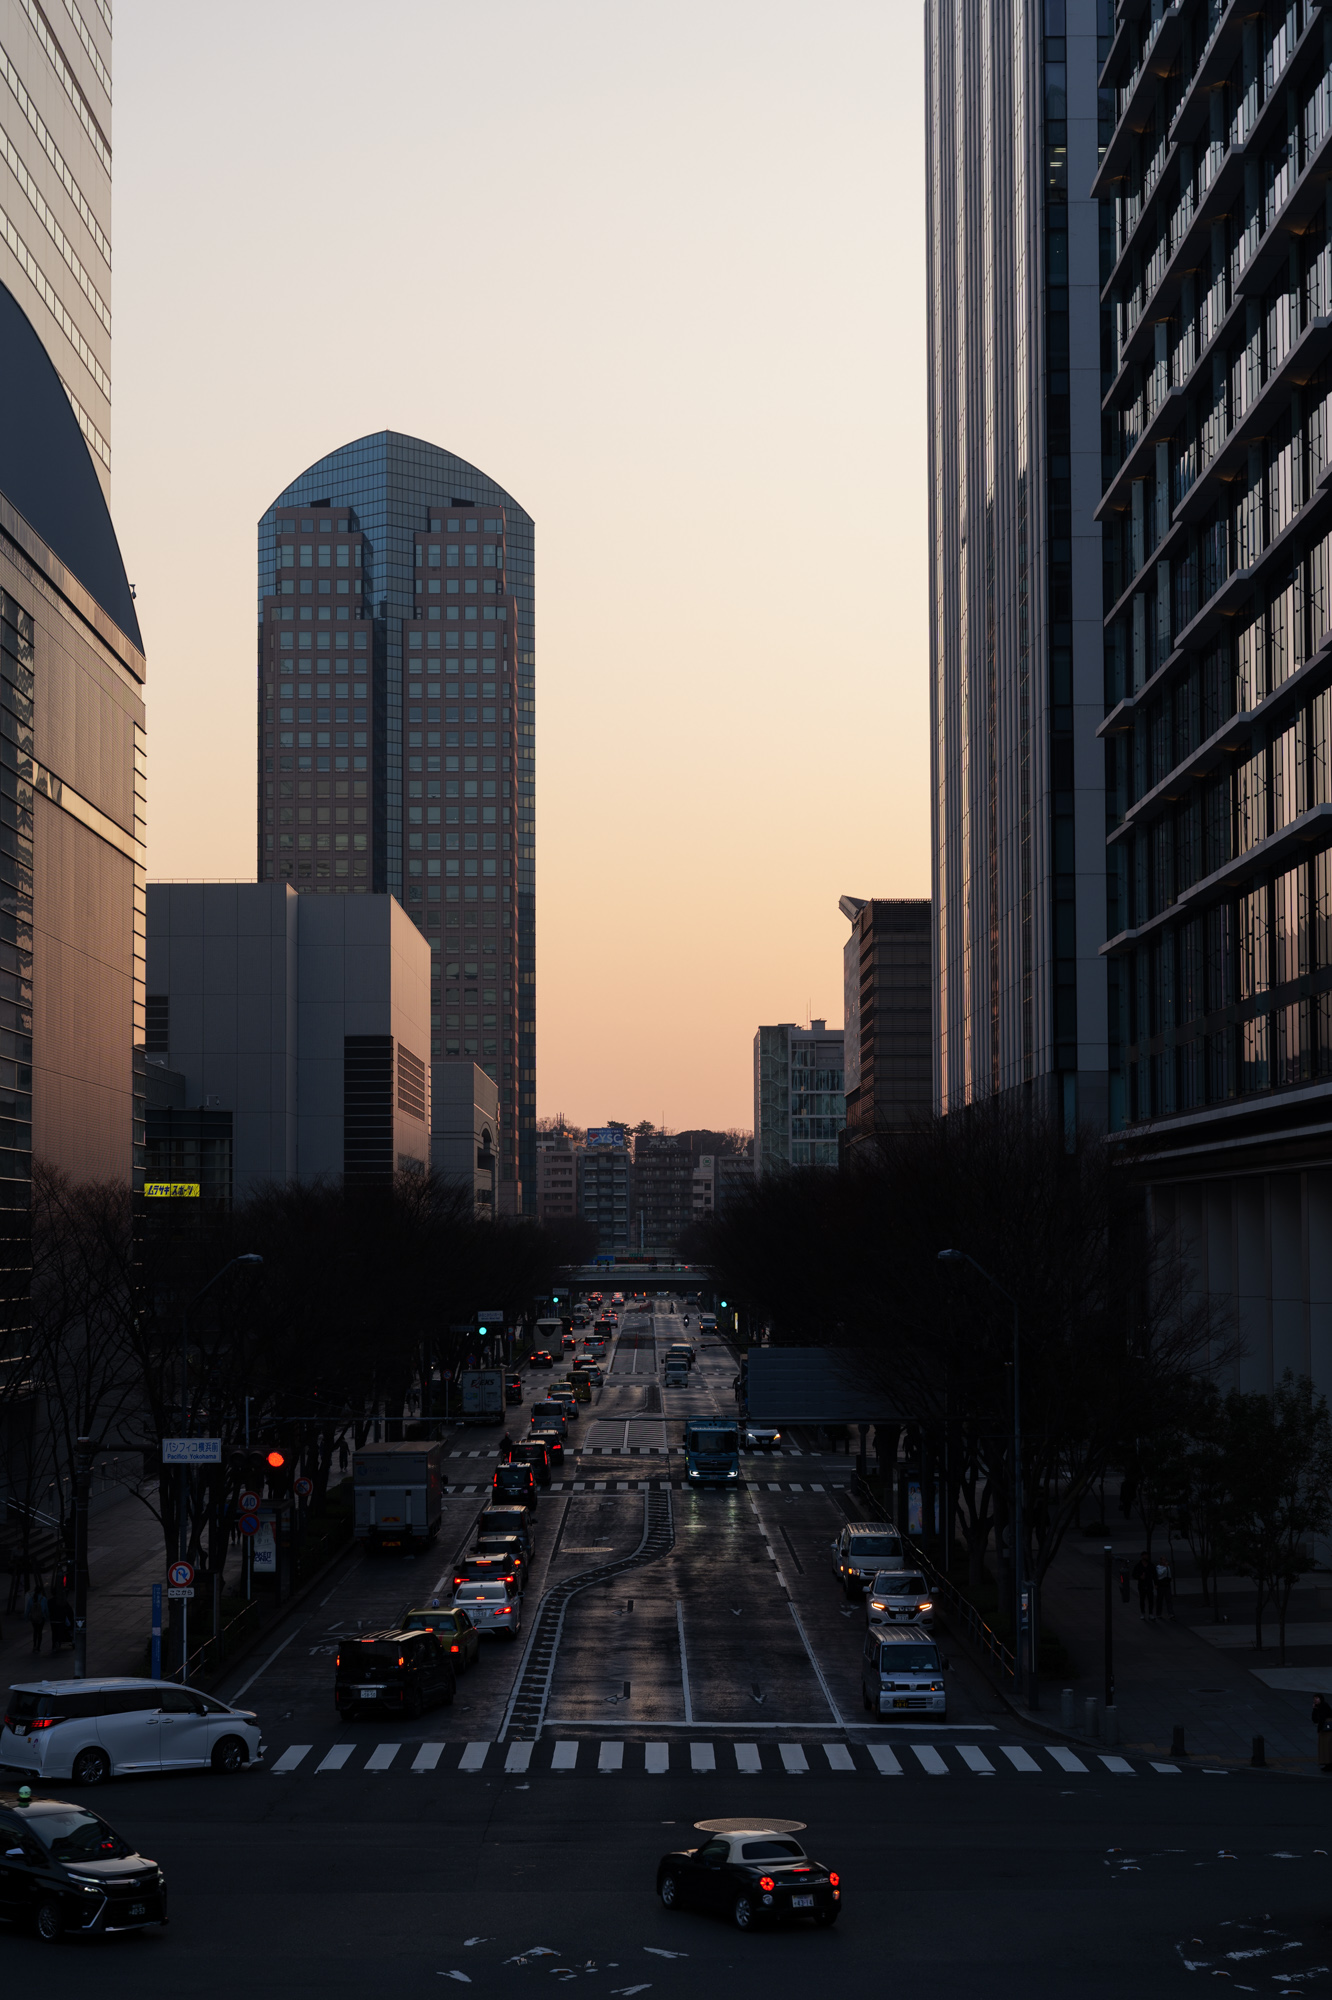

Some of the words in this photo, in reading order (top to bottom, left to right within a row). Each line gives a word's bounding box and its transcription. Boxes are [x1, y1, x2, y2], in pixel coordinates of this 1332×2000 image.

[599, 1133, 621, 1143] YSC
[165, 1442, 219, 1453] パシフィコ横浜前
[244, 1497, 256, 1507] 40
